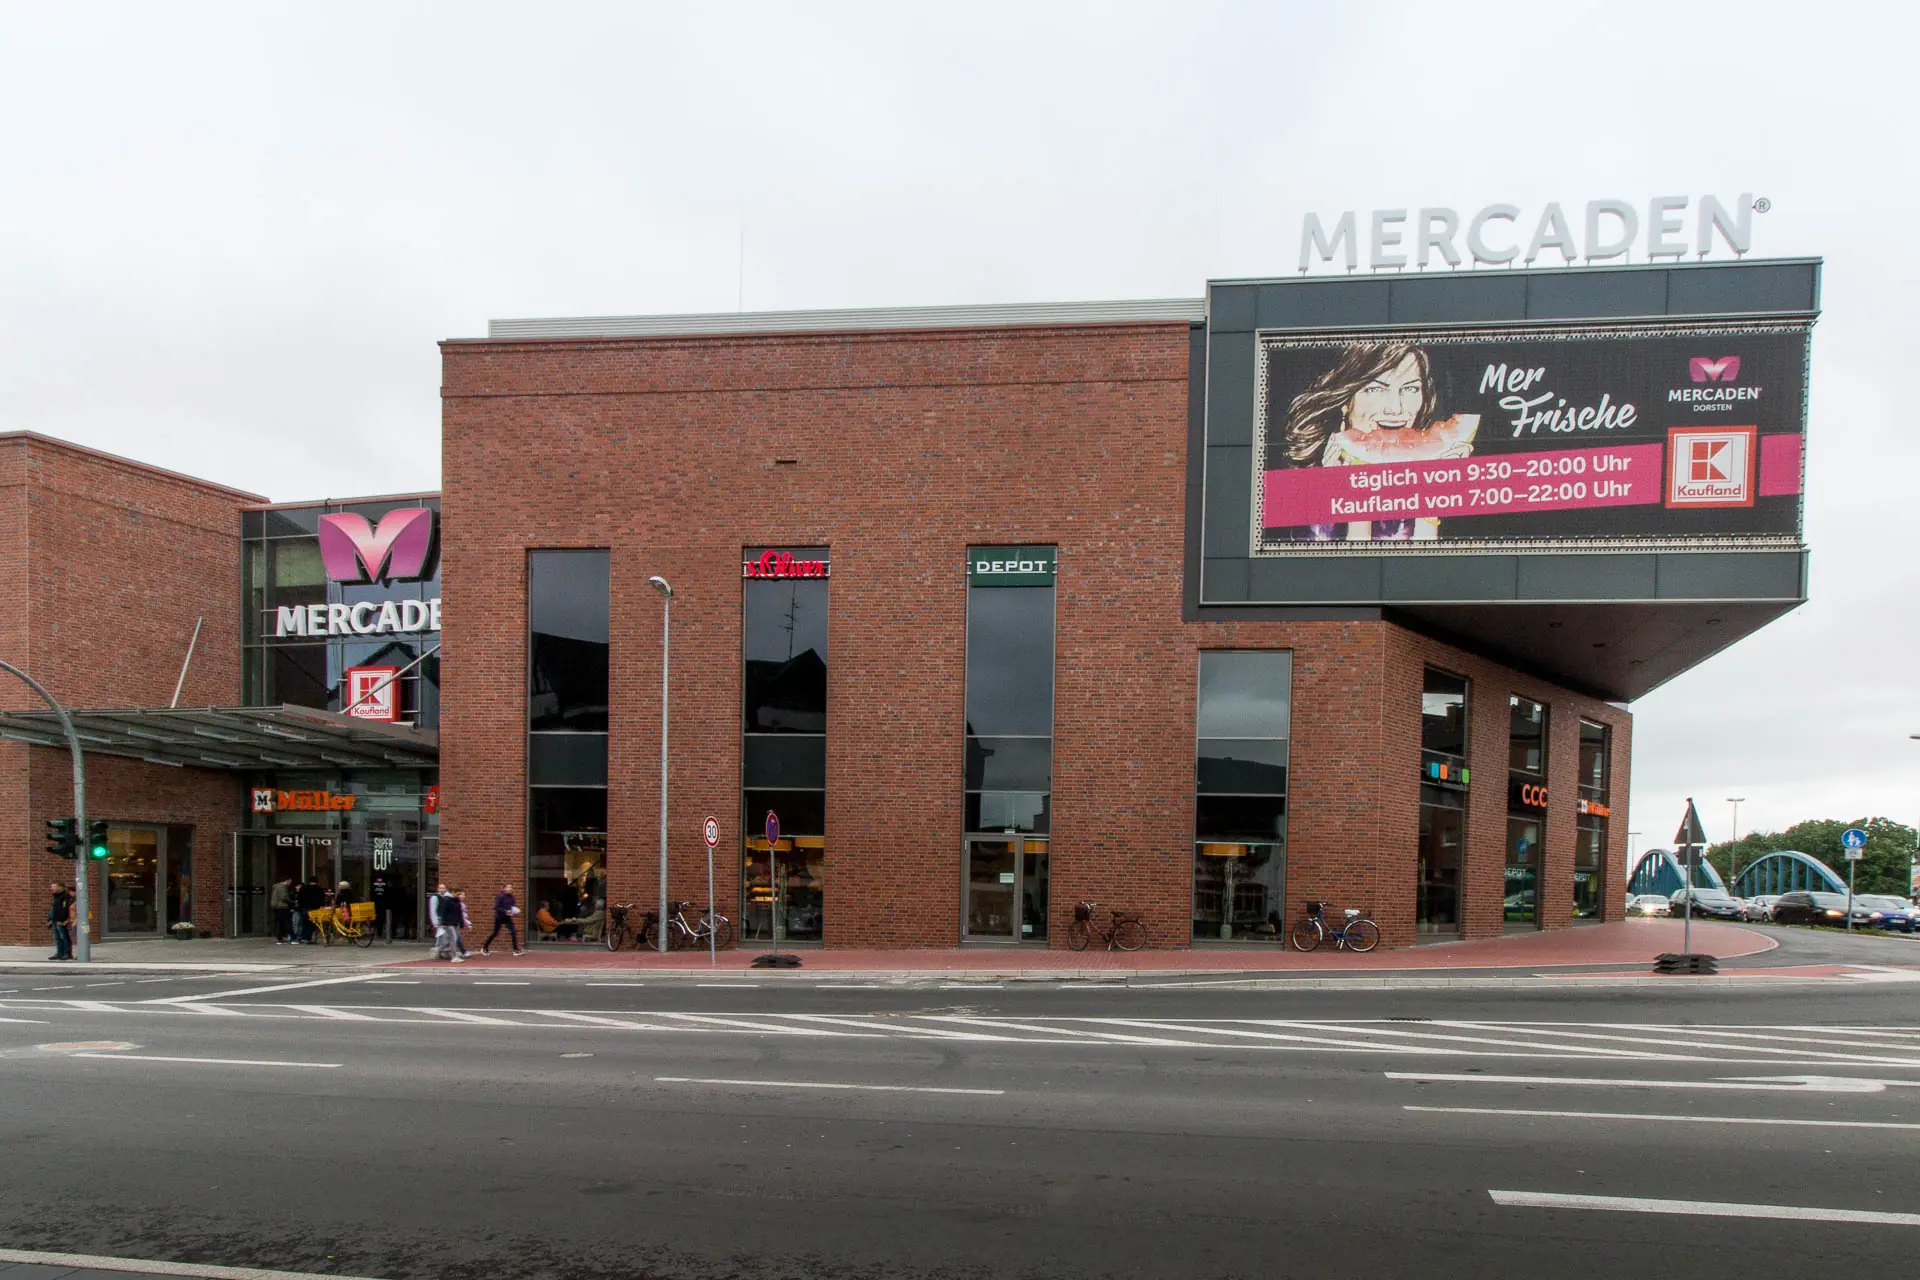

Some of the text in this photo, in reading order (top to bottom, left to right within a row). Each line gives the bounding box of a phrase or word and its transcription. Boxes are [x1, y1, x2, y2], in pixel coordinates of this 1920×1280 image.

[1479, 363, 1545, 394] Mer
[1499, 392, 1637, 438] Frische
[1693, 403, 1732, 412] DORSTEN
[1349, 468, 1418, 493] täglich
[1423, 468, 1461, 483] von
[1592, 454, 1632, 473] Uhr
[1330, 494, 1420, 516] Kaufland
[1424, 494, 1463, 509] von
[1593, 480, 1633, 498] Uhr
[1677, 484, 1742, 496] Kaufland
[746, 549, 825, 579] s.Oliver
[976, 560, 1047, 573] DEPOT
[354, 706, 390, 716] Kaufland
[277, 791, 357, 811] Müller
[1522, 783, 1548, 808] CCC
[707, 825, 717, 839] 30
[374, 837, 393, 849] SUPER
[374, 849, 393, 870] CUT
